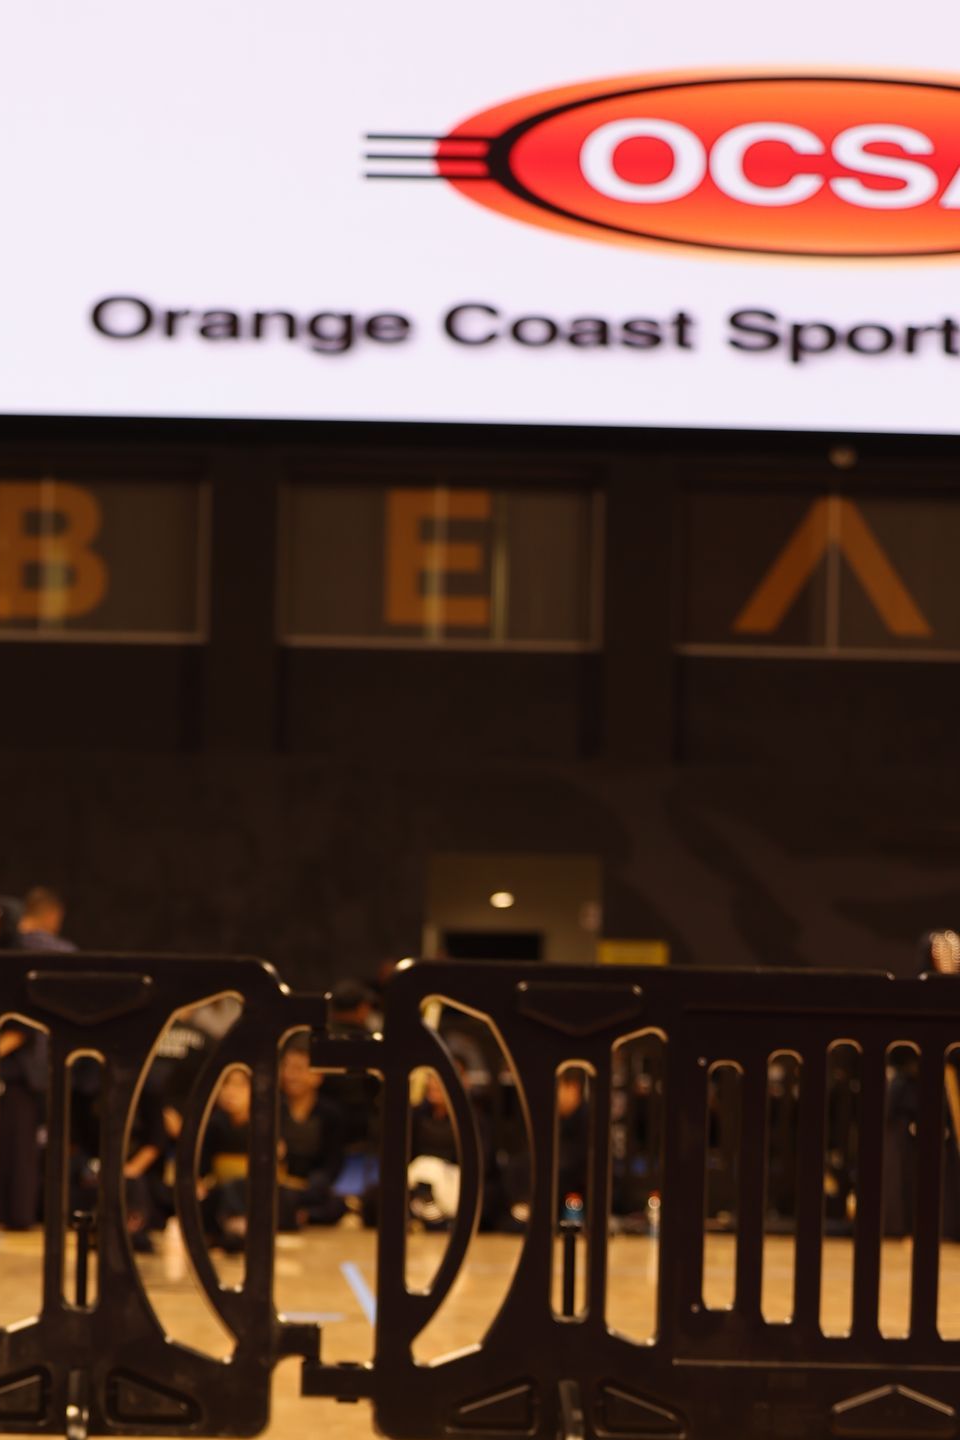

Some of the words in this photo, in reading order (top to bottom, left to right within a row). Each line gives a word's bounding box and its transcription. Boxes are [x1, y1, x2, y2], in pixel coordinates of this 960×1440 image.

[579, 117, 960, 210] OCS
[89, 295, 413, 356] Orange
[444, 302, 696, 352] Coast
[729, 307, 960, 365] Sport
